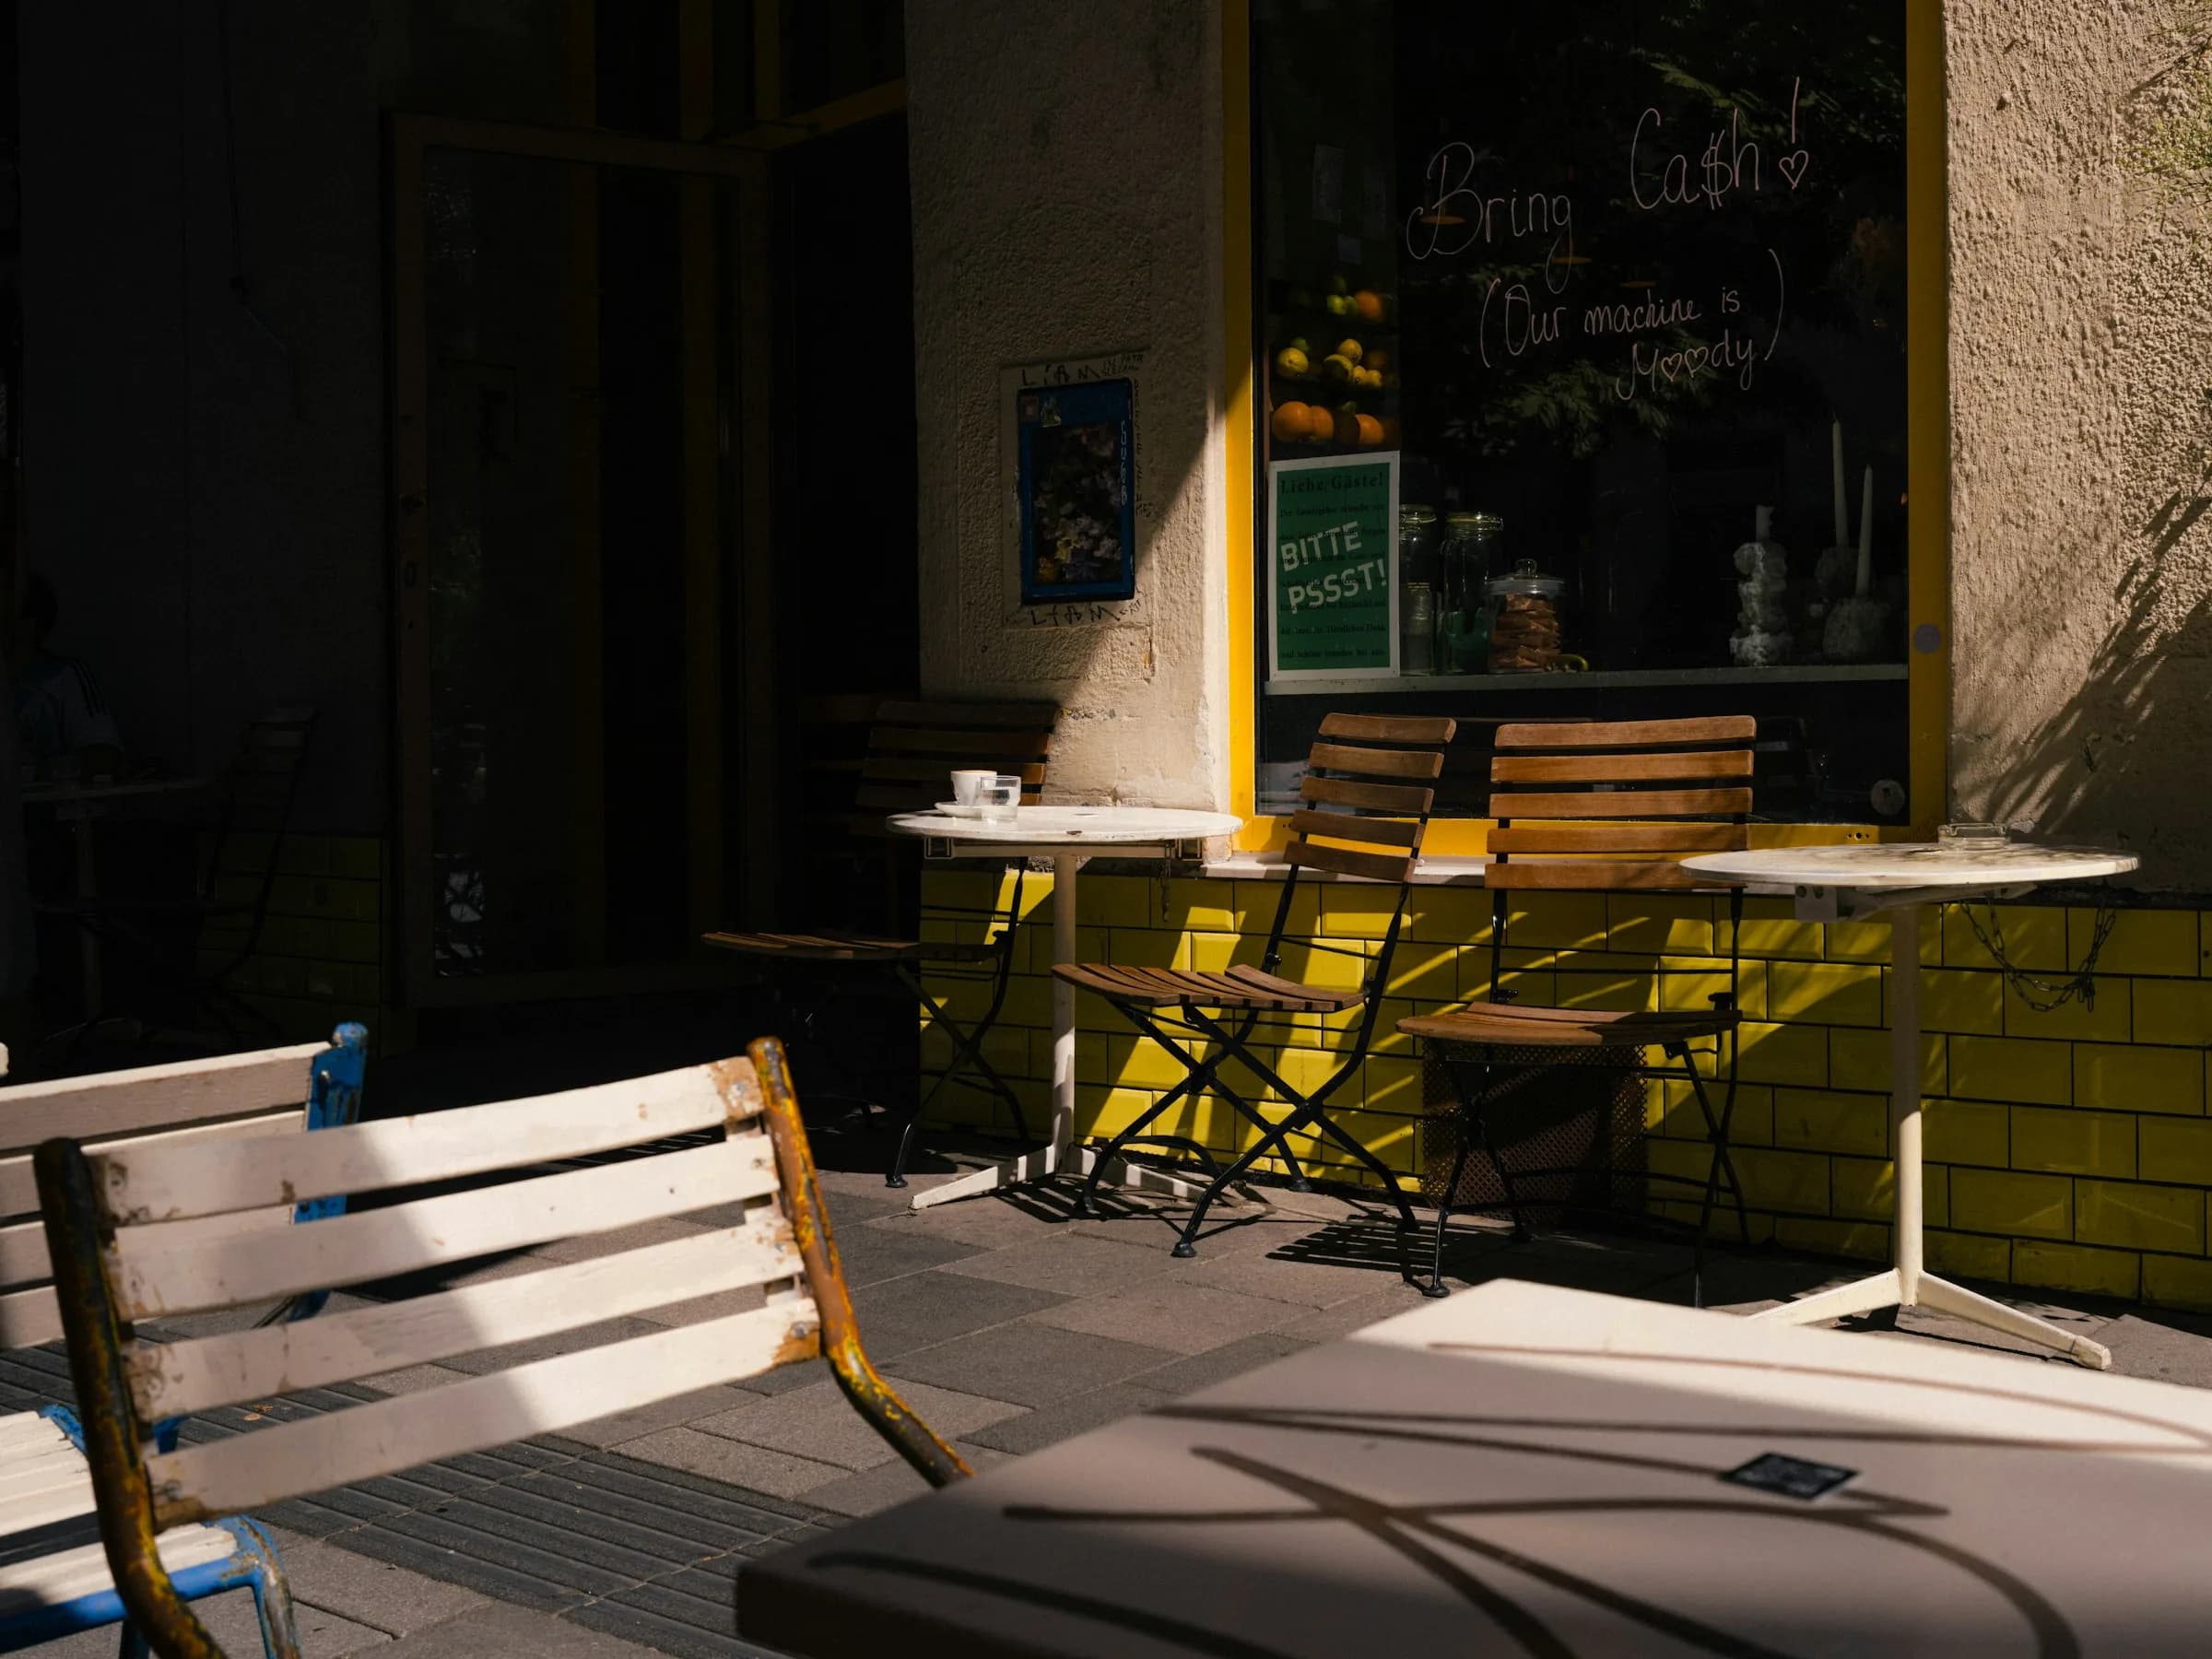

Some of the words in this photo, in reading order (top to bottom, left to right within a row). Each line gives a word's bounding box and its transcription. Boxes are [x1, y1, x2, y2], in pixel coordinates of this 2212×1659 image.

[1406, 141, 1573, 294] Bring
[1479, 277, 1567, 369] (Our
[1583, 288, 1701, 336] machine
[1721, 287, 1741, 314] is
[1281, 477, 1324, 495] Liebe
[1331, 471, 1384, 490] Gäste!
[1280, 521, 1362, 572] BITTE
[1288, 559, 1387, 615] PSSST!
